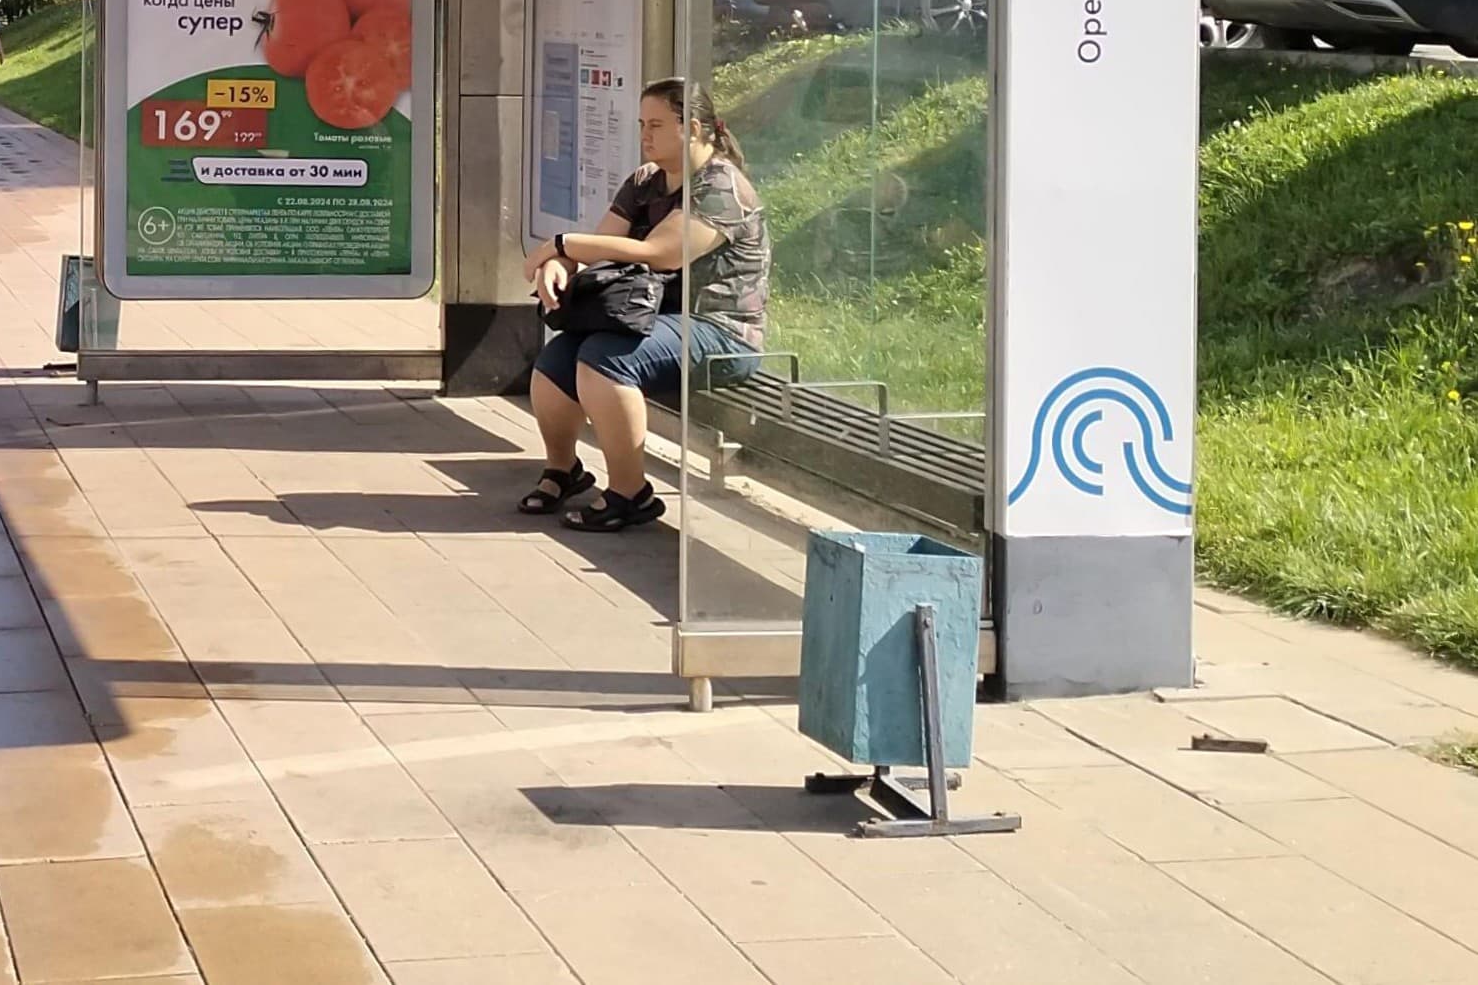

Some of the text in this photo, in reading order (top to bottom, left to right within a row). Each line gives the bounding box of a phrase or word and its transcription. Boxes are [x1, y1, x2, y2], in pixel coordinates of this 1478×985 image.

[178, 15, 243, 36] супер
[214, 85, 269, 104] -15%
[154, 109, 221, 142] 169
[313, 131, 348, 143] Томаты
[201, 166, 362, 178] и доставка от 30 мин
[143, 215, 169, 235] 6+
